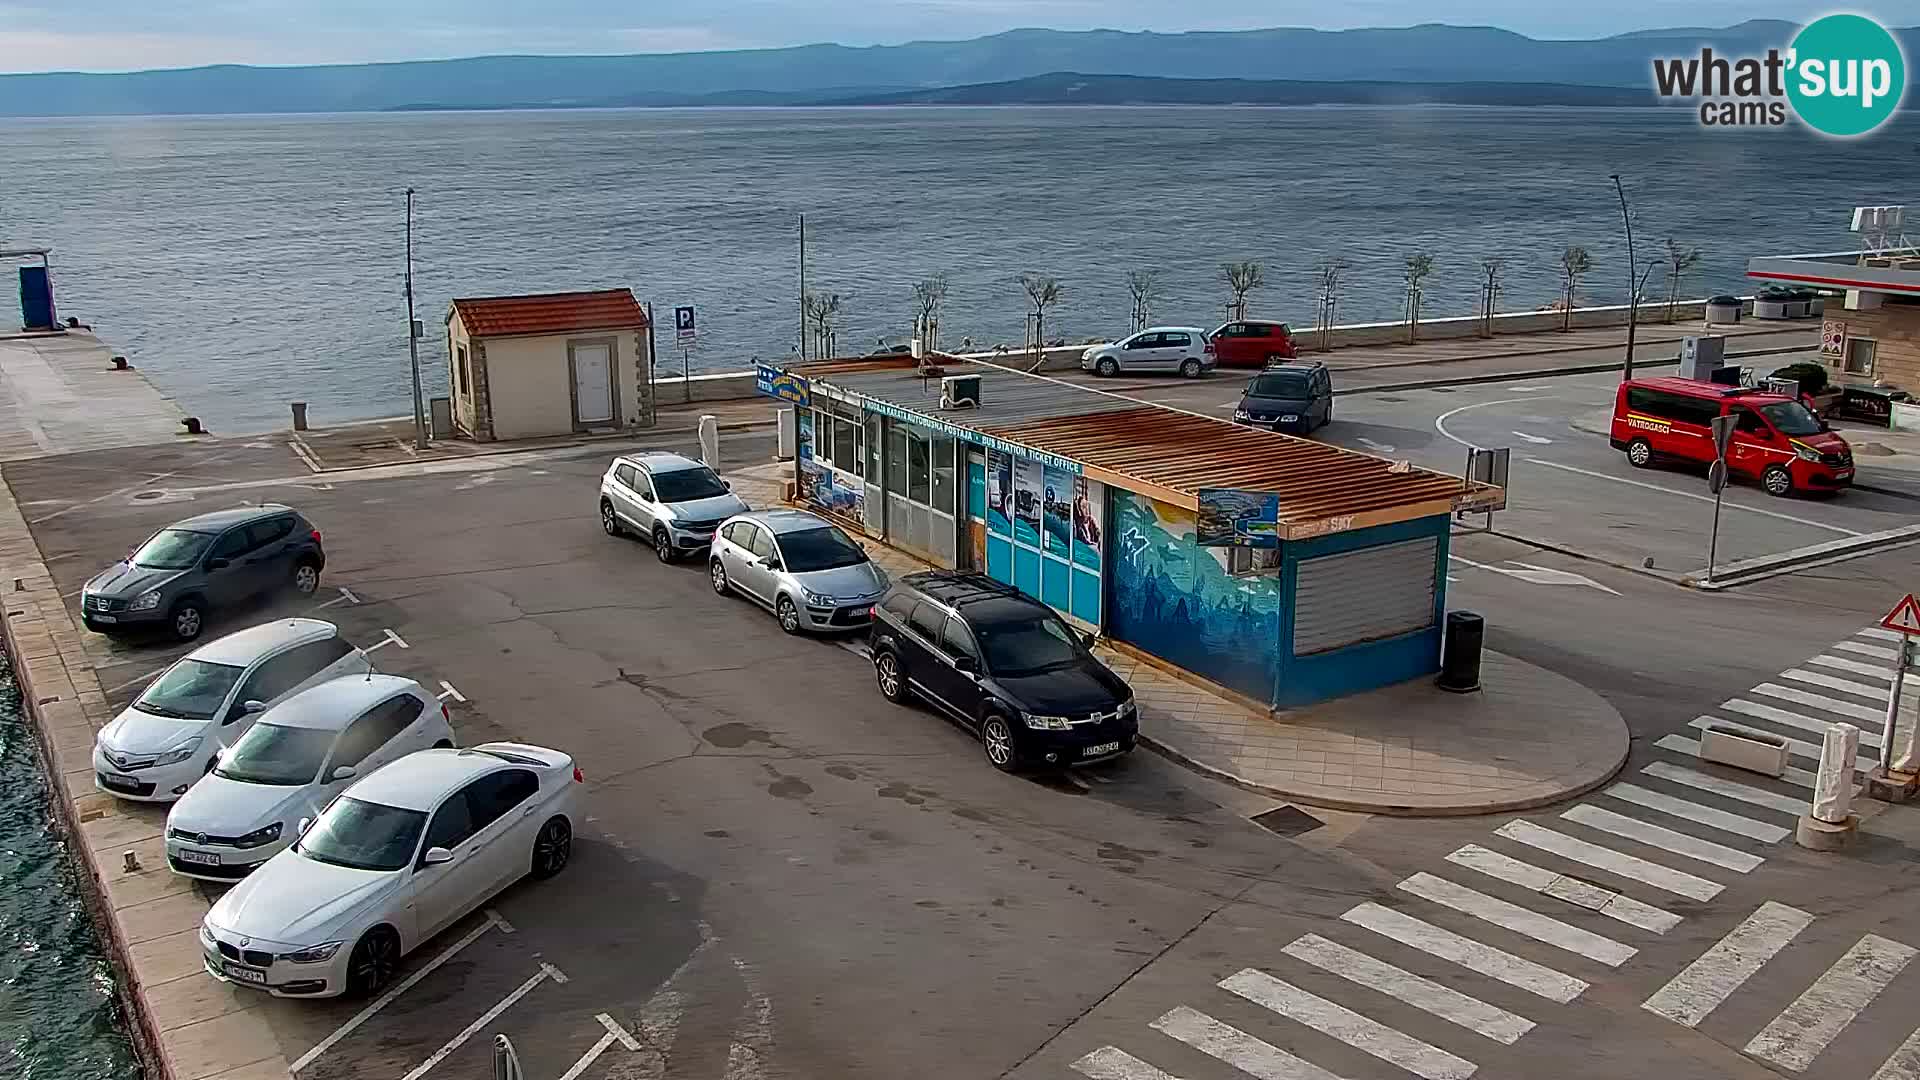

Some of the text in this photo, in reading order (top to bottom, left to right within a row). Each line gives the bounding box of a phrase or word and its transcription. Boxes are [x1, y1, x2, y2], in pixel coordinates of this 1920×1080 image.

[680, 310, 690, 327] P
[943, 424, 972, 441] POSTAJA
[1627, 418, 1670, 434] VATROGASCI
[982, 435, 1079, 473] BUS STATION TICKET OFFICE
